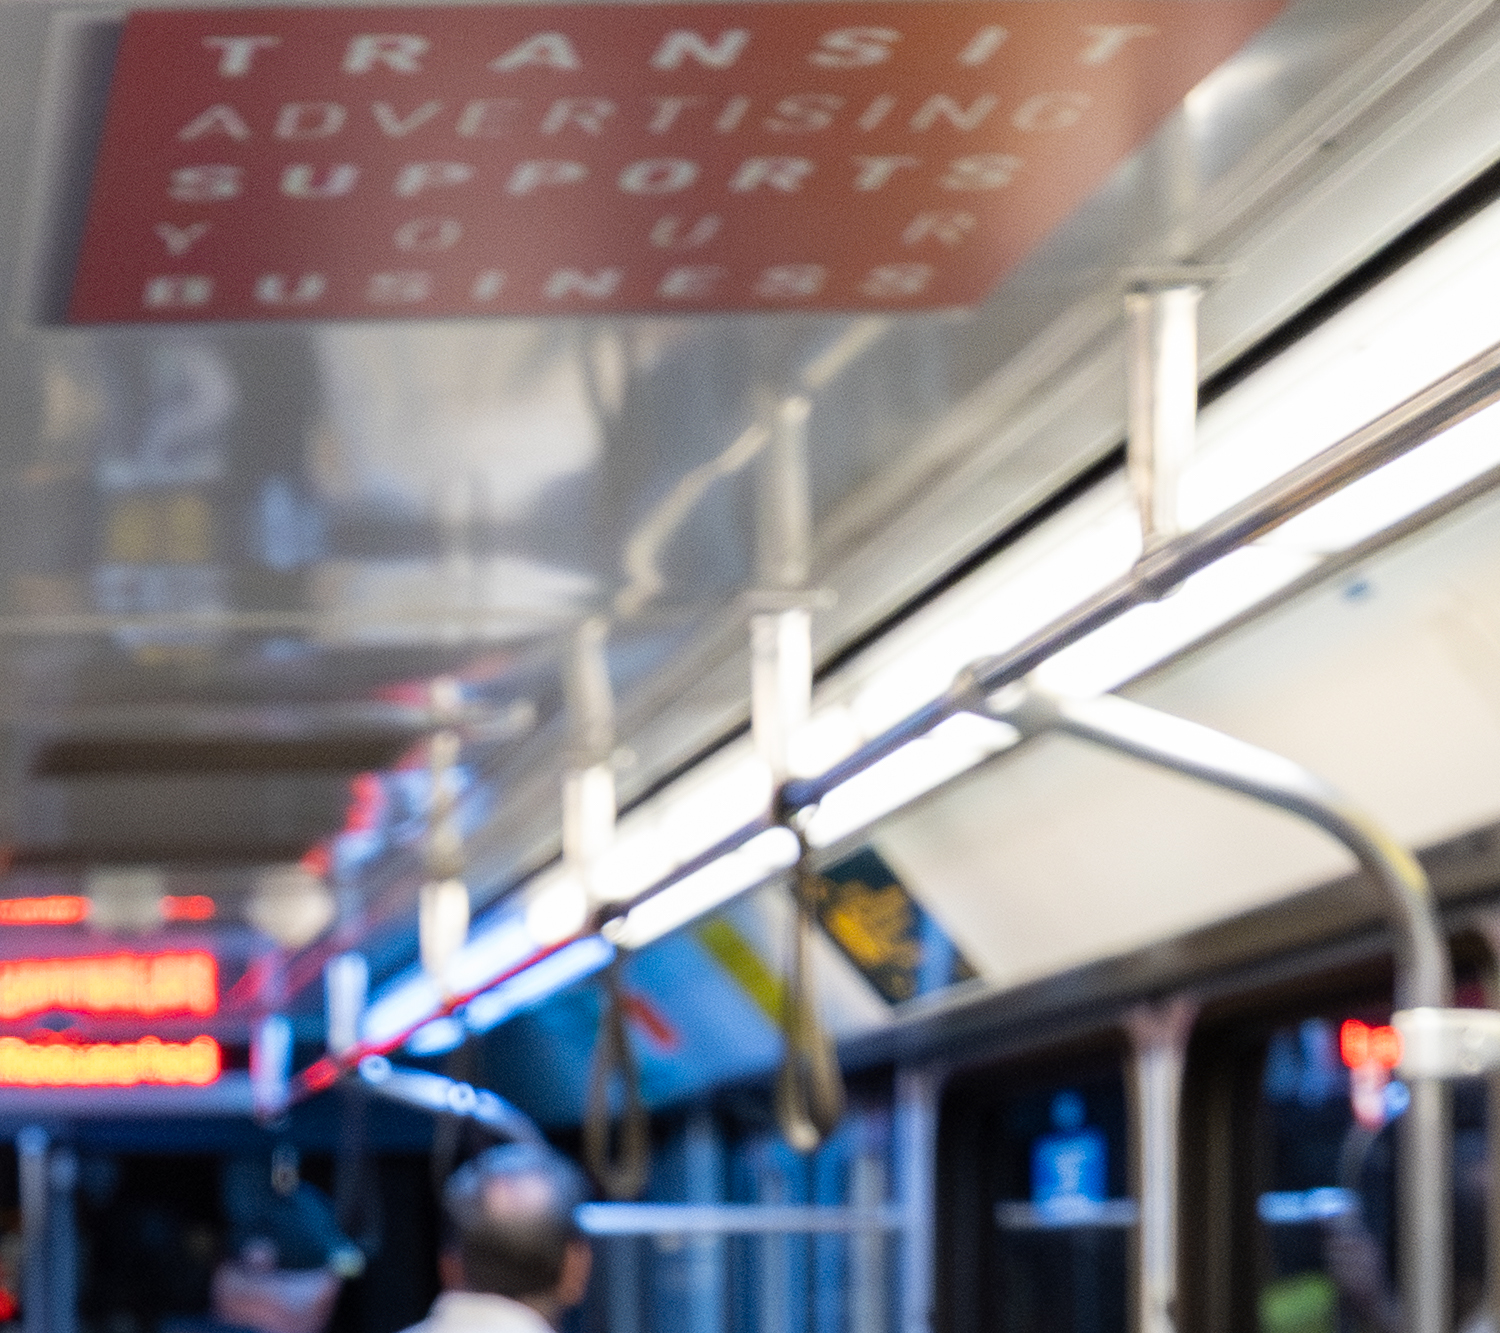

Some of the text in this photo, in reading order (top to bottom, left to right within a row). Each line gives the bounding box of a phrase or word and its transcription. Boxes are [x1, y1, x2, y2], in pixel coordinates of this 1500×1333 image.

[203, 26, 1158, 77] TRANSIT
[176, 91, 1093, 143] ADVERTISING
[169, 154, 1023, 200] SUPPORTS
[153, 213, 976, 257] YOUR
[142, 265, 936, 308] BUSINESS
